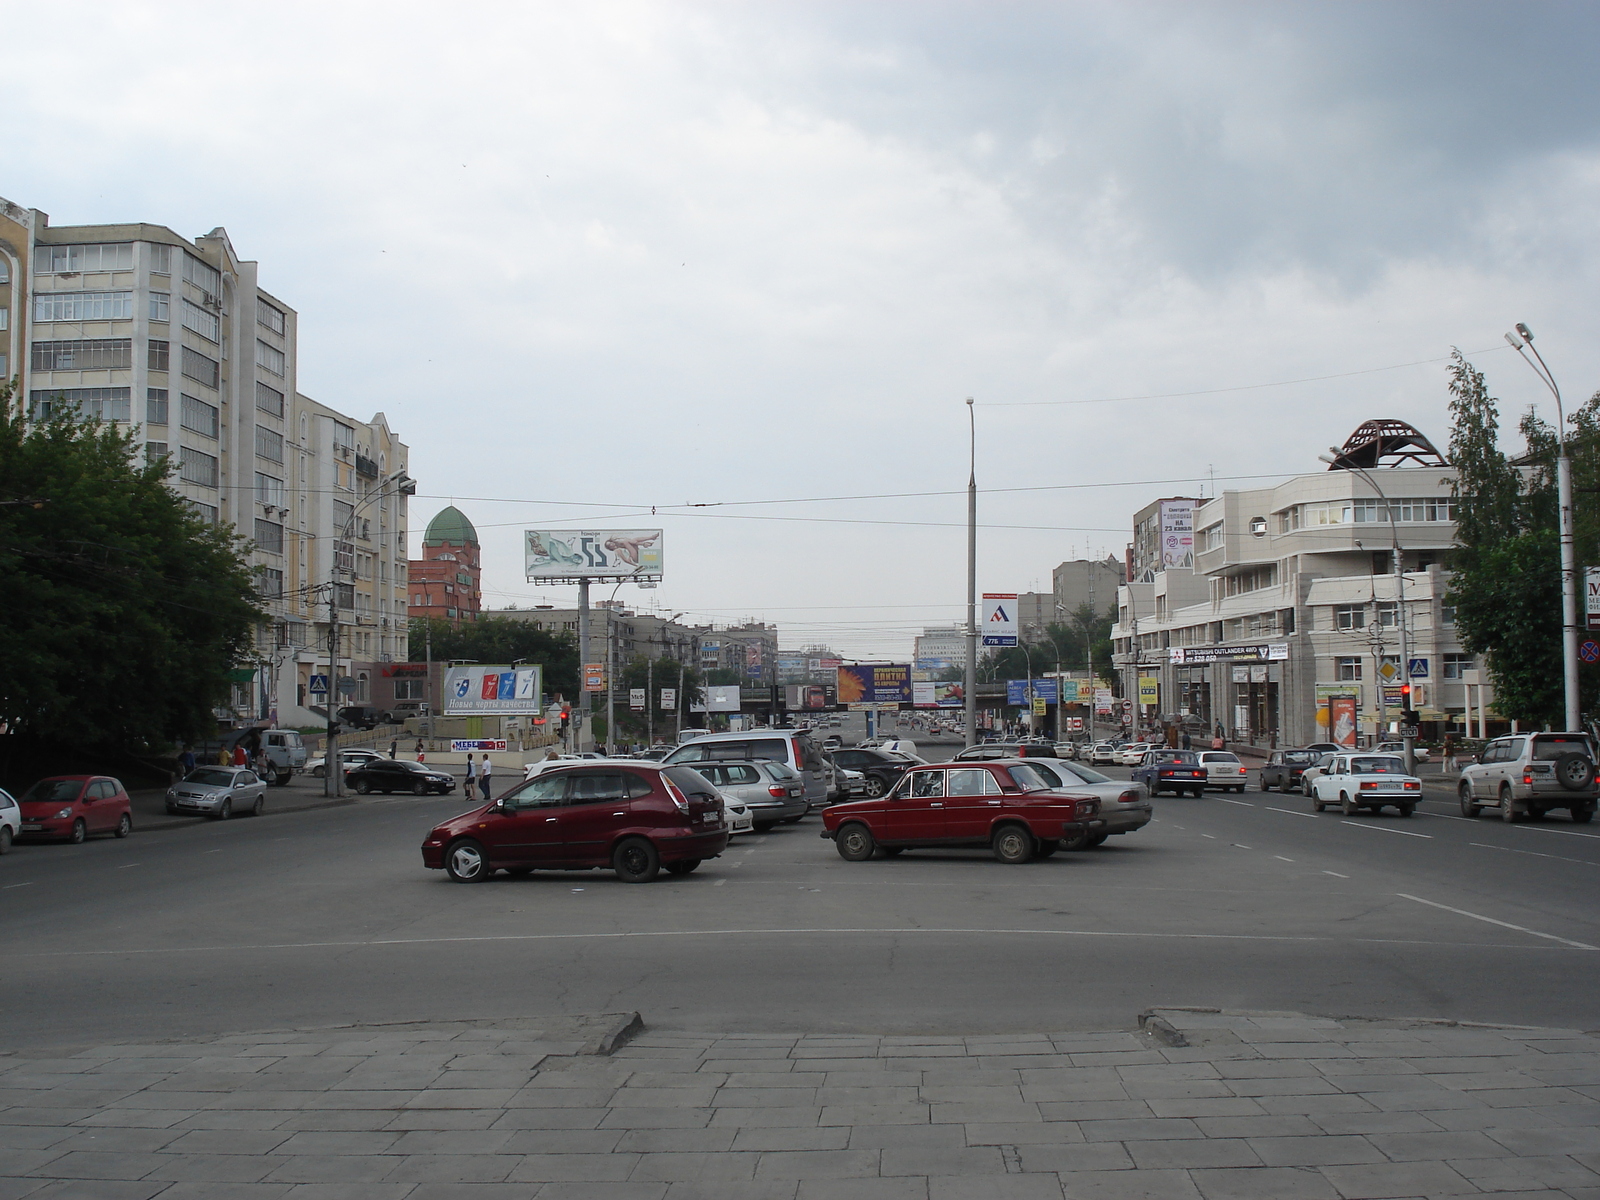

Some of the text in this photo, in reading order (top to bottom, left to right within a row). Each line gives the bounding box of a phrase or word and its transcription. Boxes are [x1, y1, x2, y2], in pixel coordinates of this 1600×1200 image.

[1214, 647, 1245, 655] OUTLANDER
[874, 672, 907, 680] ПЛИТКА
[448, 699, 535, 710] Новые черты качества
[1400, 728, 1418, 736] СТОП
